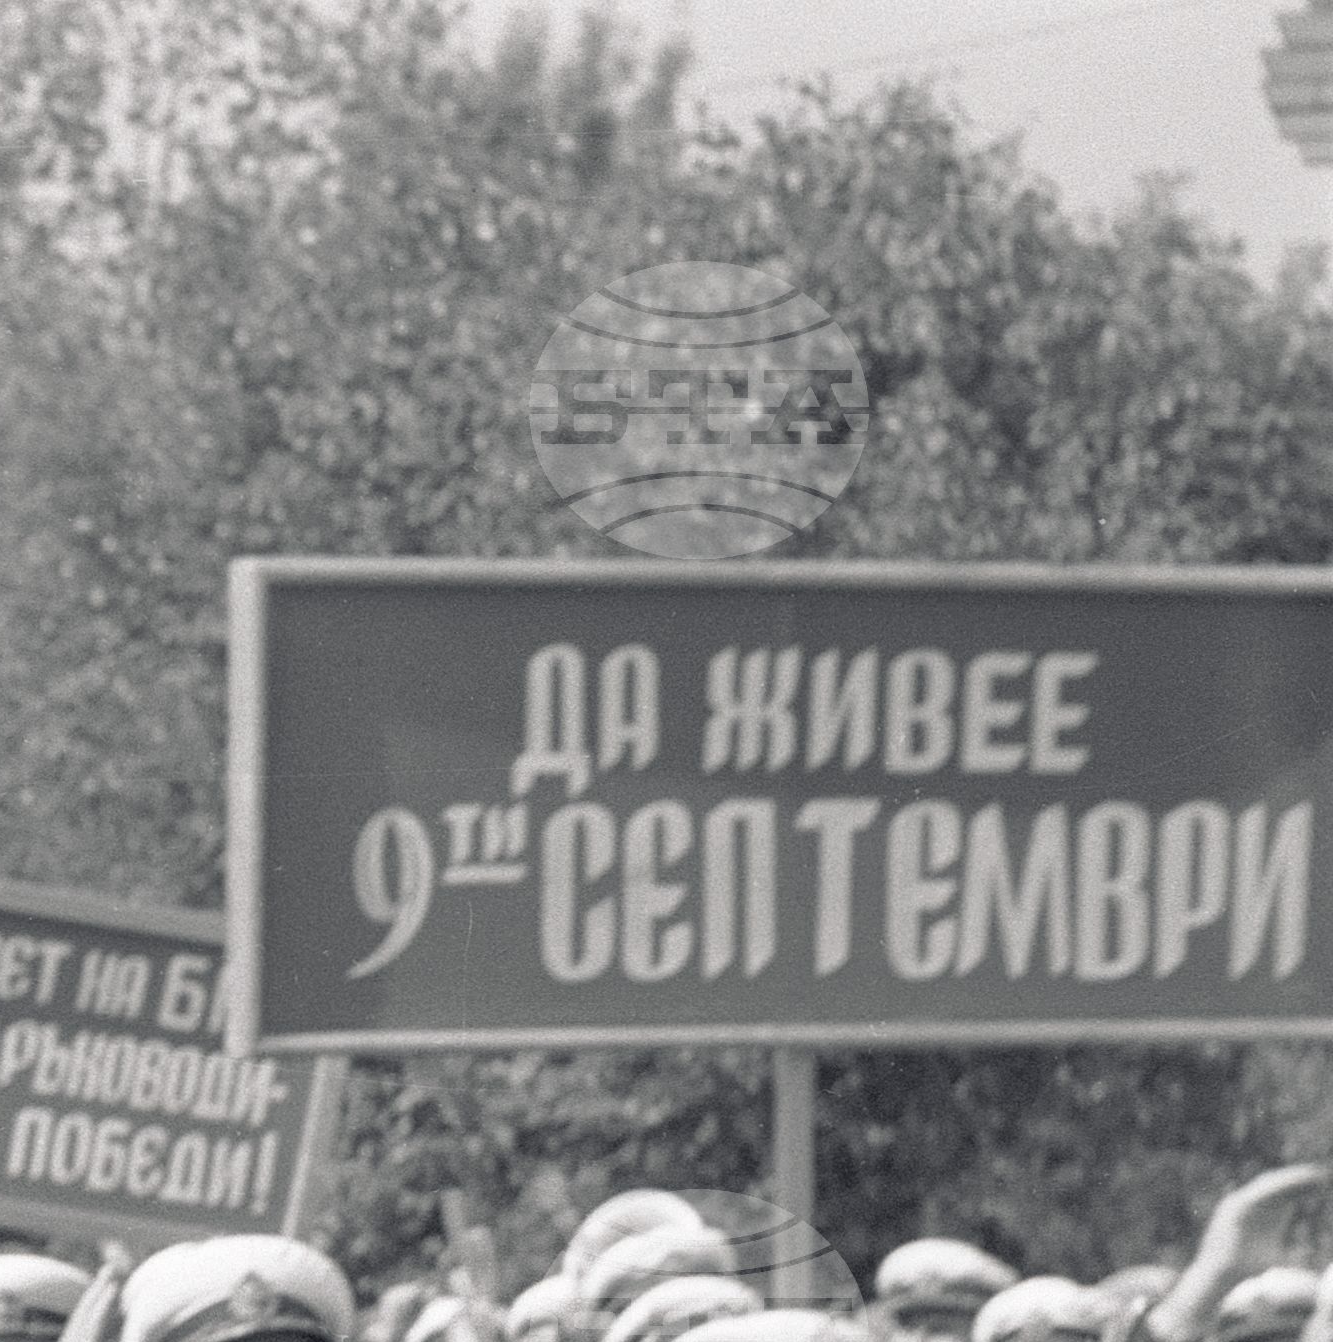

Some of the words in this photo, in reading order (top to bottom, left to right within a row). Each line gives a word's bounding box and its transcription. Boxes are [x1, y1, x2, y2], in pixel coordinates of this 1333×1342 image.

[512, 643, 661, 796] ДА
[700, 645, 1099, 774] ЖИВЕЕ
[539, 798, 1313, 983] СЕПТЕМВРИ
[75, 947, 152, 1020] НА
[6, 1103, 280, 1217] ПОБЕДИ!
